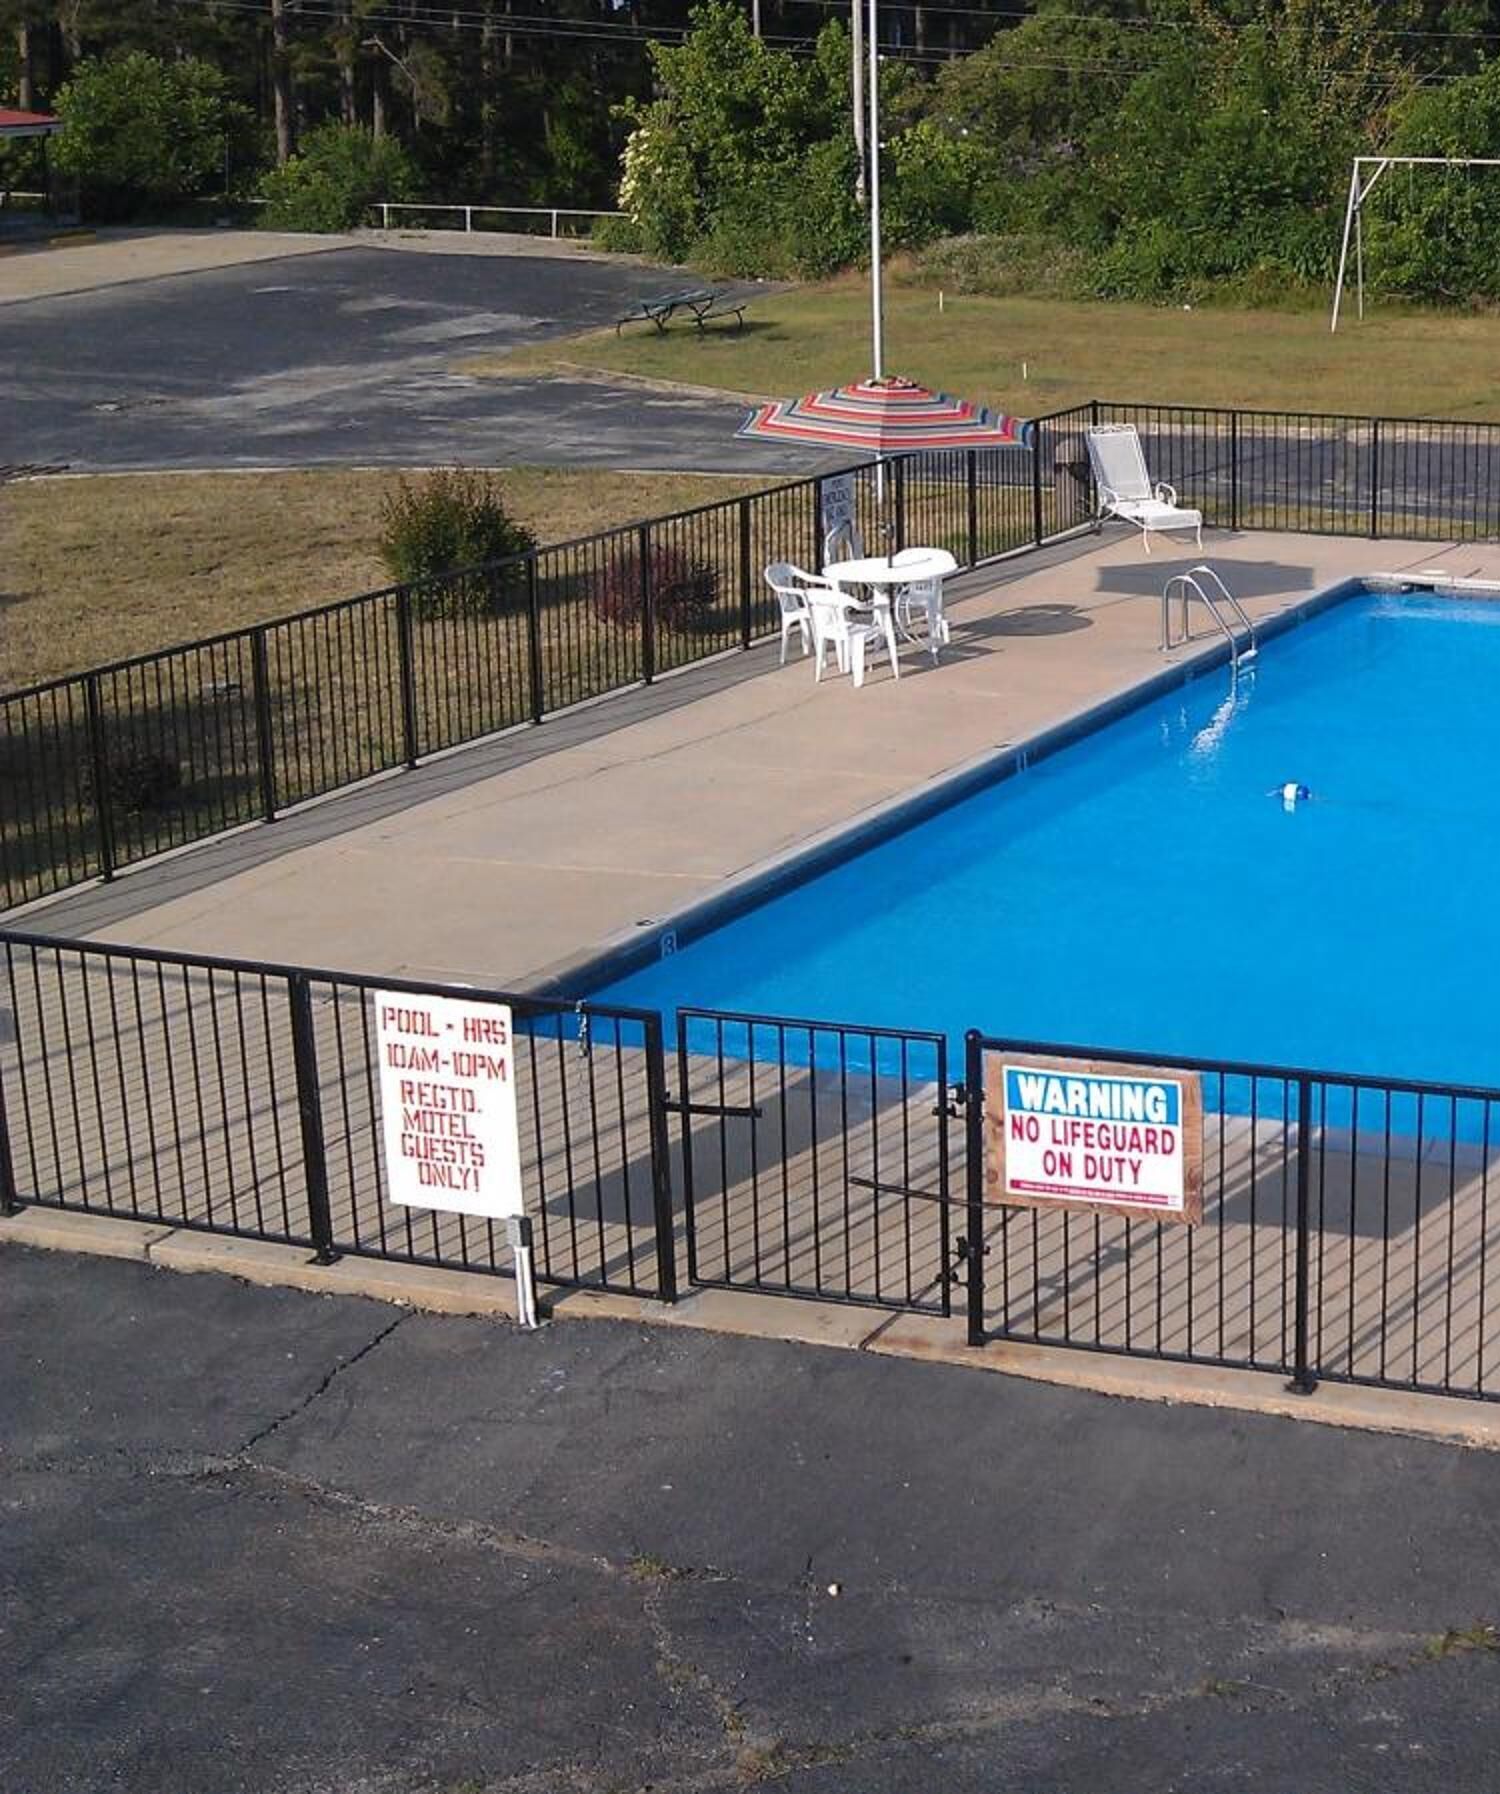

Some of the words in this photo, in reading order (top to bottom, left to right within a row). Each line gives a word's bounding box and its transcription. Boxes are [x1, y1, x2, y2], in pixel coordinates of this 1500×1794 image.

[382, 1006, 440, 1037] POOL
[463, 1016, 507, 1045] HRS
[387, 1043, 506, 1082] 10AM-10PM
[1016, 1073, 1168, 1124] WARNING
[403, 1107, 476, 1139] MOTEL
[1011, 1114, 1040, 1143] NO
[1051, 1119, 1176, 1156] LIFEGUARD
[401, 1133, 485, 1167] GUESTS
[1043, 1150, 1073, 1179] ON
[1084, 1154, 1142, 1185] DUTY
[418, 1161, 479, 1192] ONLY!
